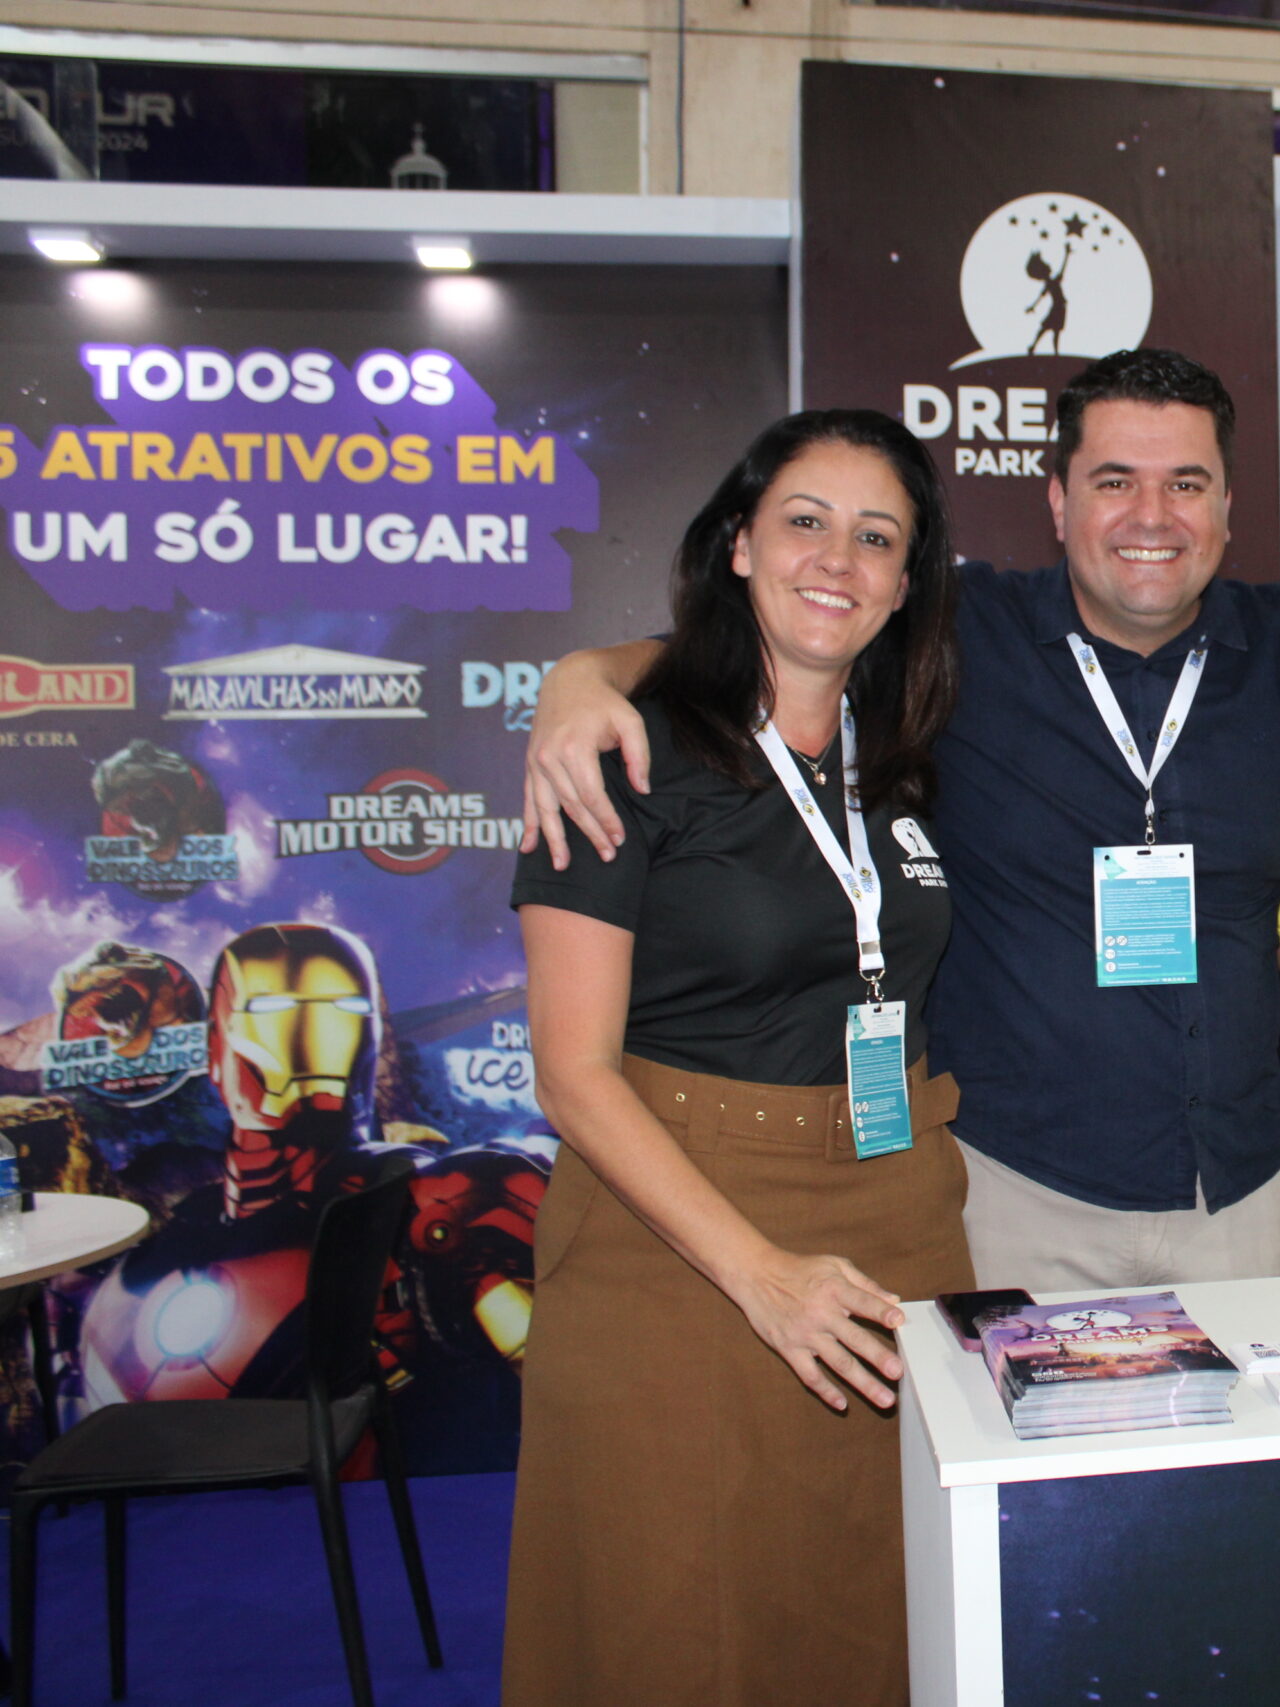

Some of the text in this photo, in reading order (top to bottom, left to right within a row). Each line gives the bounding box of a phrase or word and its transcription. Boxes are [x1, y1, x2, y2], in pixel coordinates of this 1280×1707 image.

[87, 349, 455, 405] TODOS OS
[903, 383, 1059, 442] DRE
[40, 431, 432, 484] ATRATIVOS
[457, 435, 556, 484] EM
[955, 447, 1046, 477] PARK
[13, 497, 528, 564] UM SÓ LUGAR!
[0, 670, 127, 702] LAND
[168, 674, 318, 711] MARAVILHAS
[337, 673, 423, 711] MUNDO
[24, 731, 79, 747] CERA
[330, 793, 486, 820] DREAMS
[181, 838, 224, 856] DOS
[280, 818, 525, 856] MOTOR SHOW
[87, 860, 239, 881] DINOSSAUROS
[48, 1026, 204, 1065] VALE DOS
[492, 1021, 532, 1049] DR
[46, 1047, 208, 1086] DINOSSAURO
[1030, 1324, 1170, 1342] DREAMS
